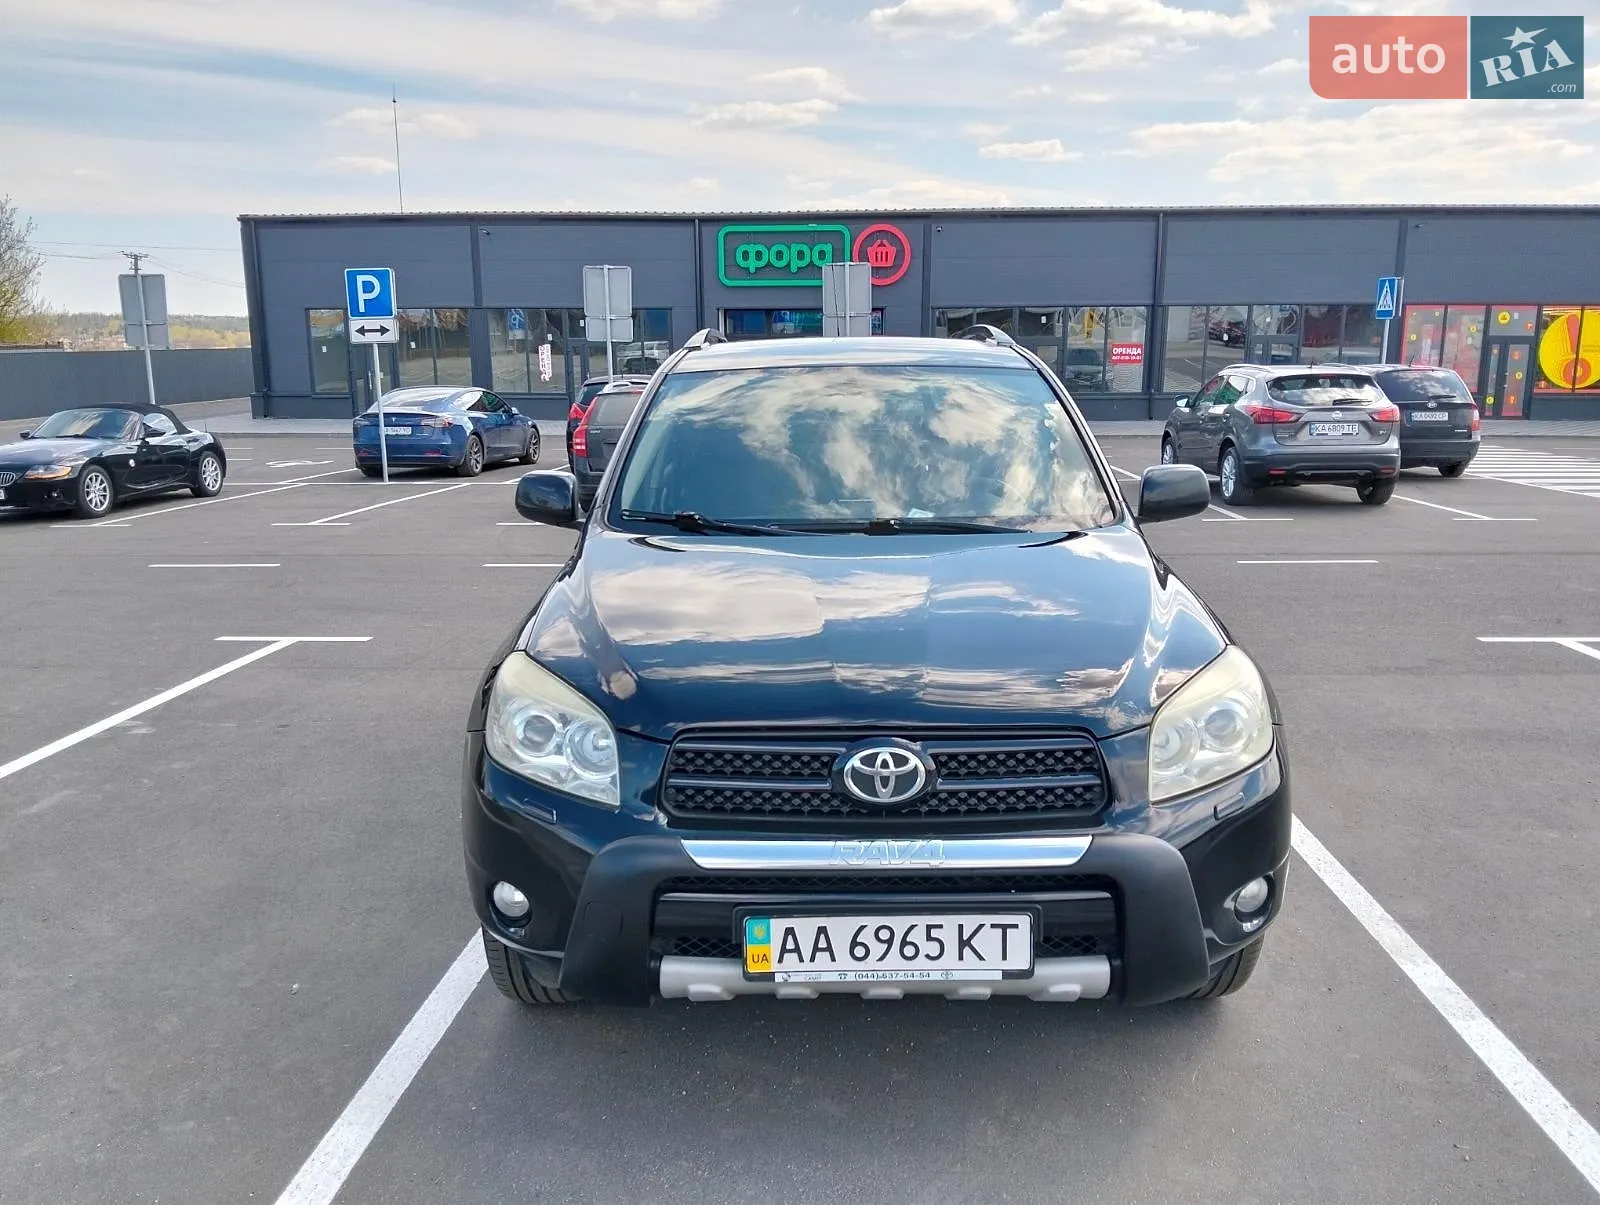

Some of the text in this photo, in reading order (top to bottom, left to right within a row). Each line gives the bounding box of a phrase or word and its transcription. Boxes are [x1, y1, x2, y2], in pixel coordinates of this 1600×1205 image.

[735, 243, 833, 274] фора
[356, 274, 381, 313] P
[1112, 347, 1142, 356] ОРЕНДА
[1315, 424, 1326, 433] KA
[1346, 424, 1357, 433] TE
[829, 839, 946, 868] RAV4
[776, 922, 1020, 964] AA 6965 KT
[751, 952, 769, 964] UA
